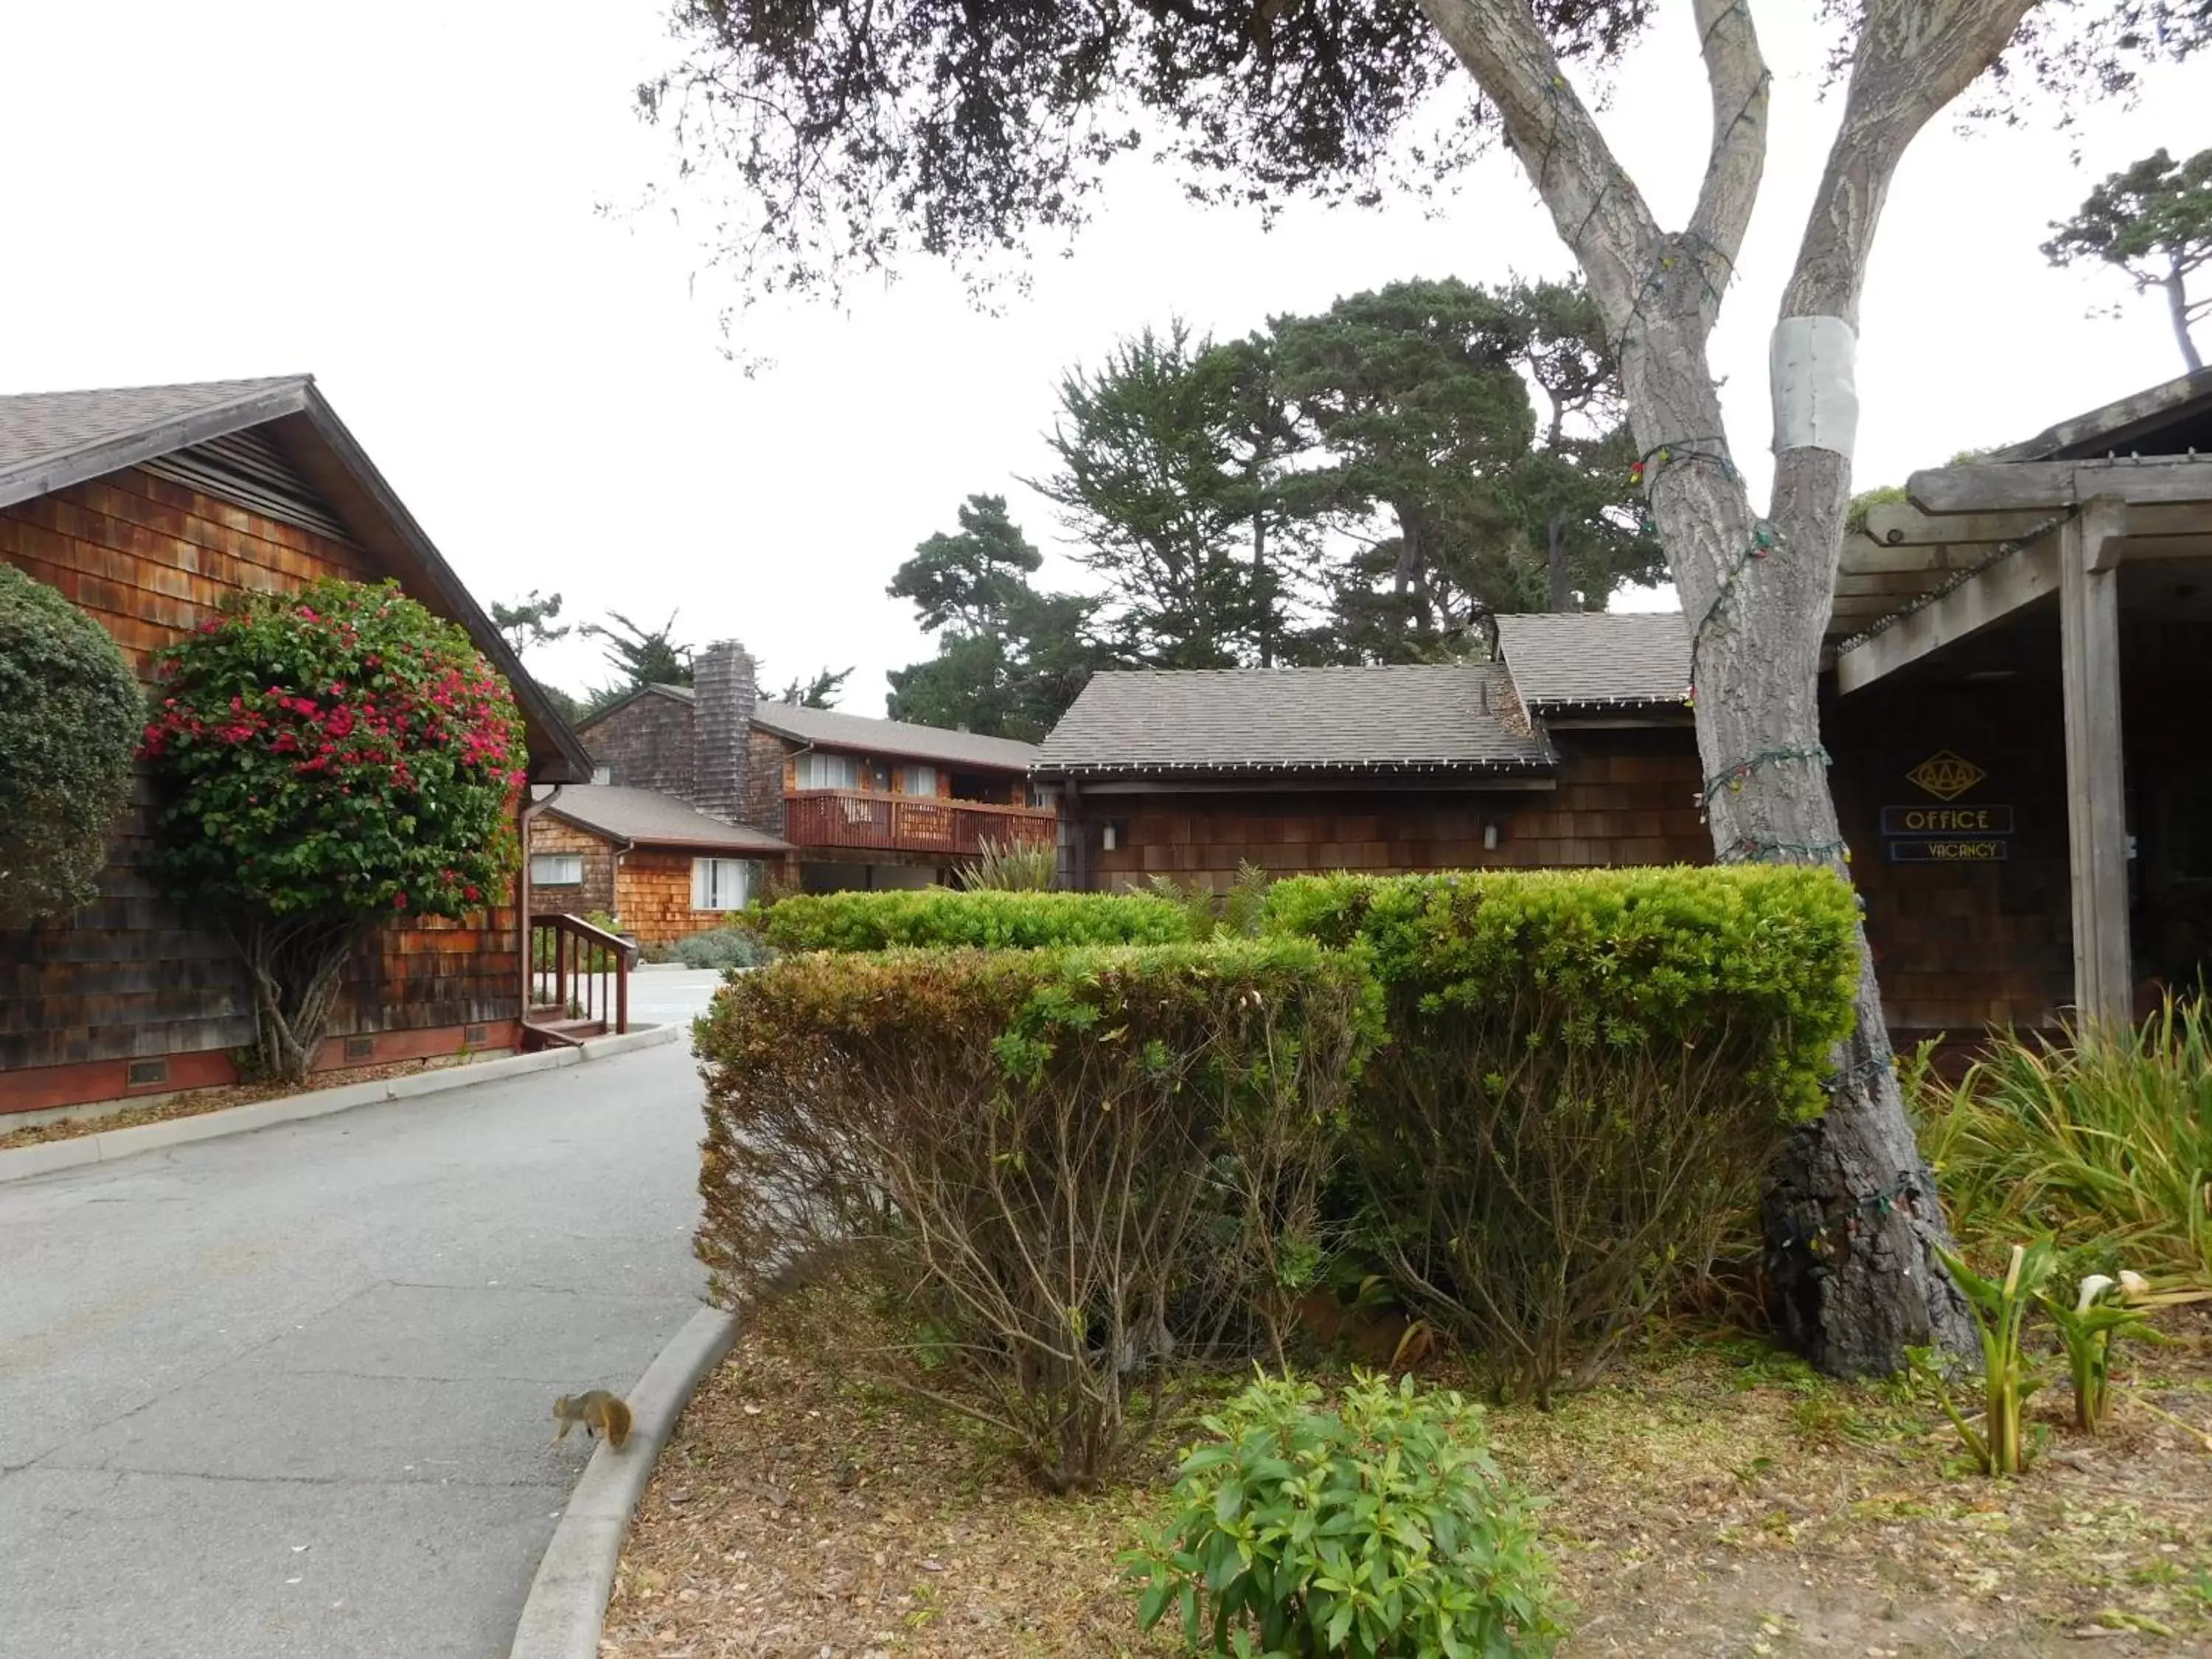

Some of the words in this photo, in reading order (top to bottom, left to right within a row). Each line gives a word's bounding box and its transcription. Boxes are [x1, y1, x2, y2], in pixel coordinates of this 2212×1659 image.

[1925, 763, 1968, 787] AAA
[1905, 810, 1989, 830] OFFICE
[1929, 844, 1996, 858] VACANCY
